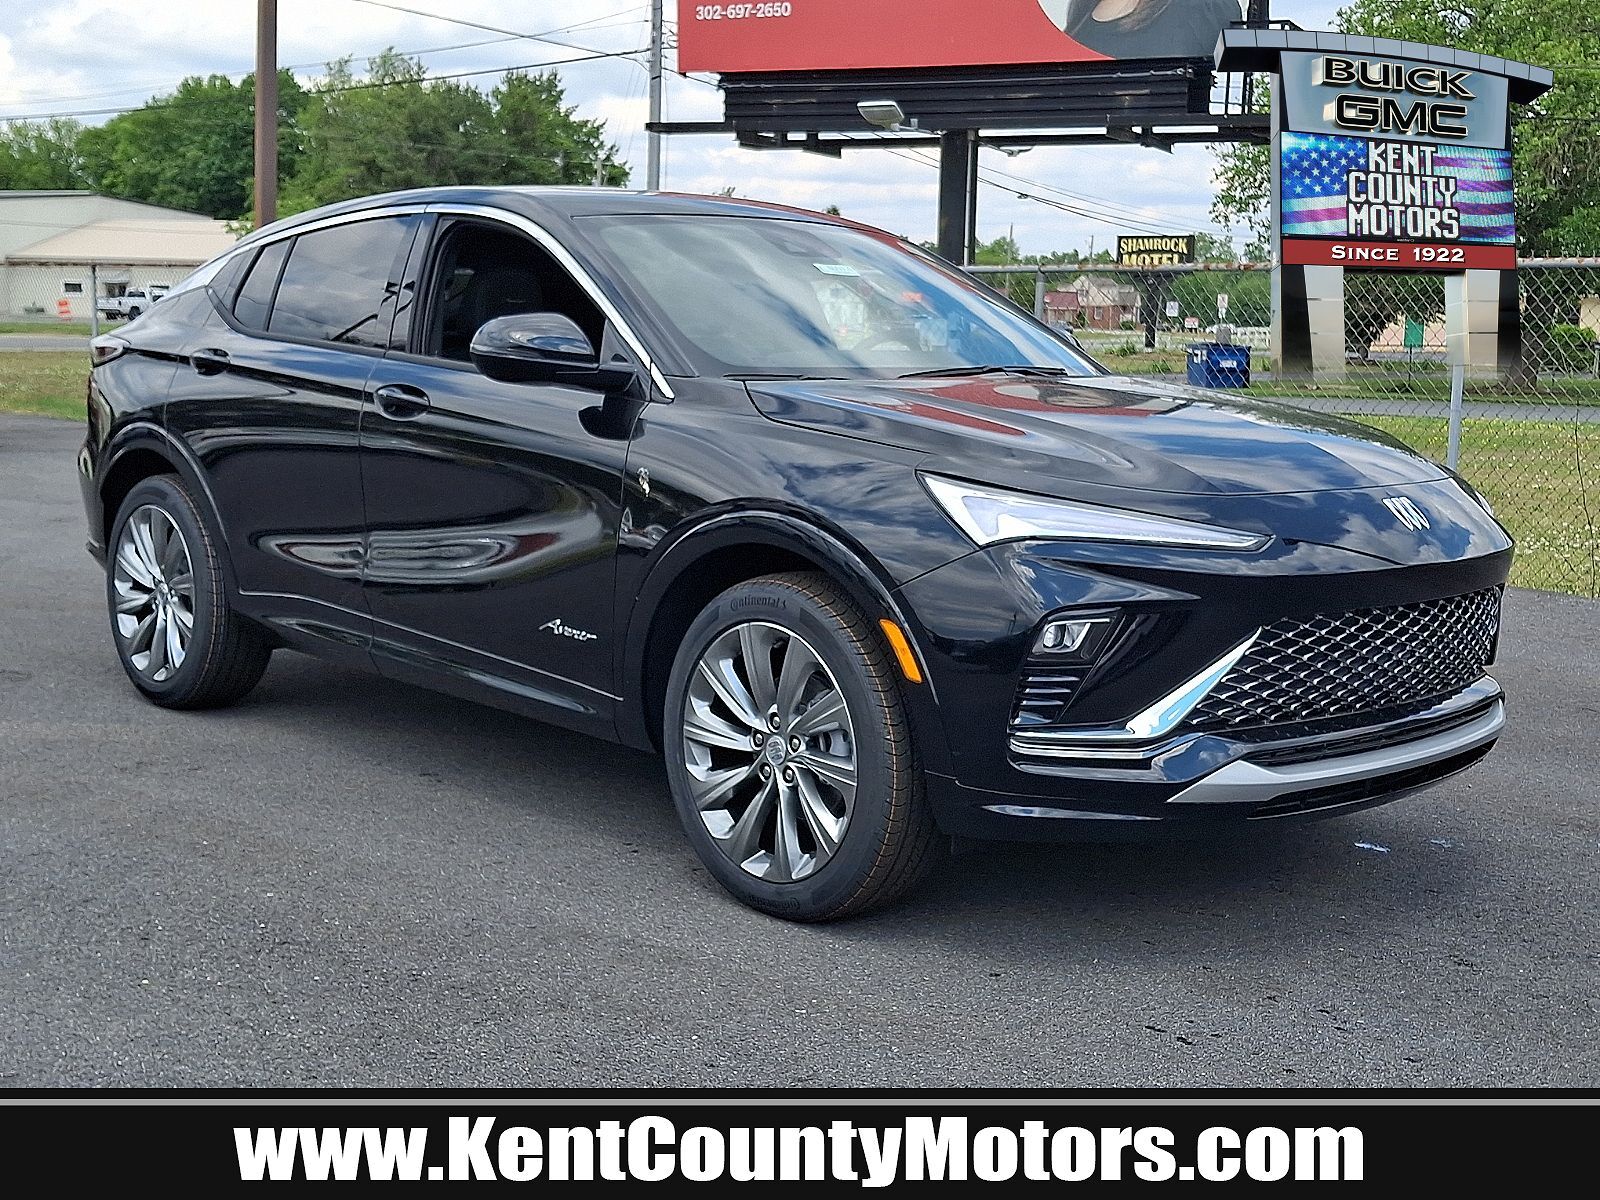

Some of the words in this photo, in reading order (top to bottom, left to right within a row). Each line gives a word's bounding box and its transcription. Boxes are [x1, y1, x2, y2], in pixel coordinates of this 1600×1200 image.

[696, 2, 791, 20] 302-697-2650
[1321, 55, 1476, 99] BUICK
[1335, 93, 1468, 137] GMC
[1368, 142, 1437, 175] KENT
[1349, 172, 1456, 207] COUNTY
[1348, 204, 1460, 239] MOTORS
[1120, 237, 1188, 255] SHAMROCK
[1413, 247, 1465, 262] 1922
